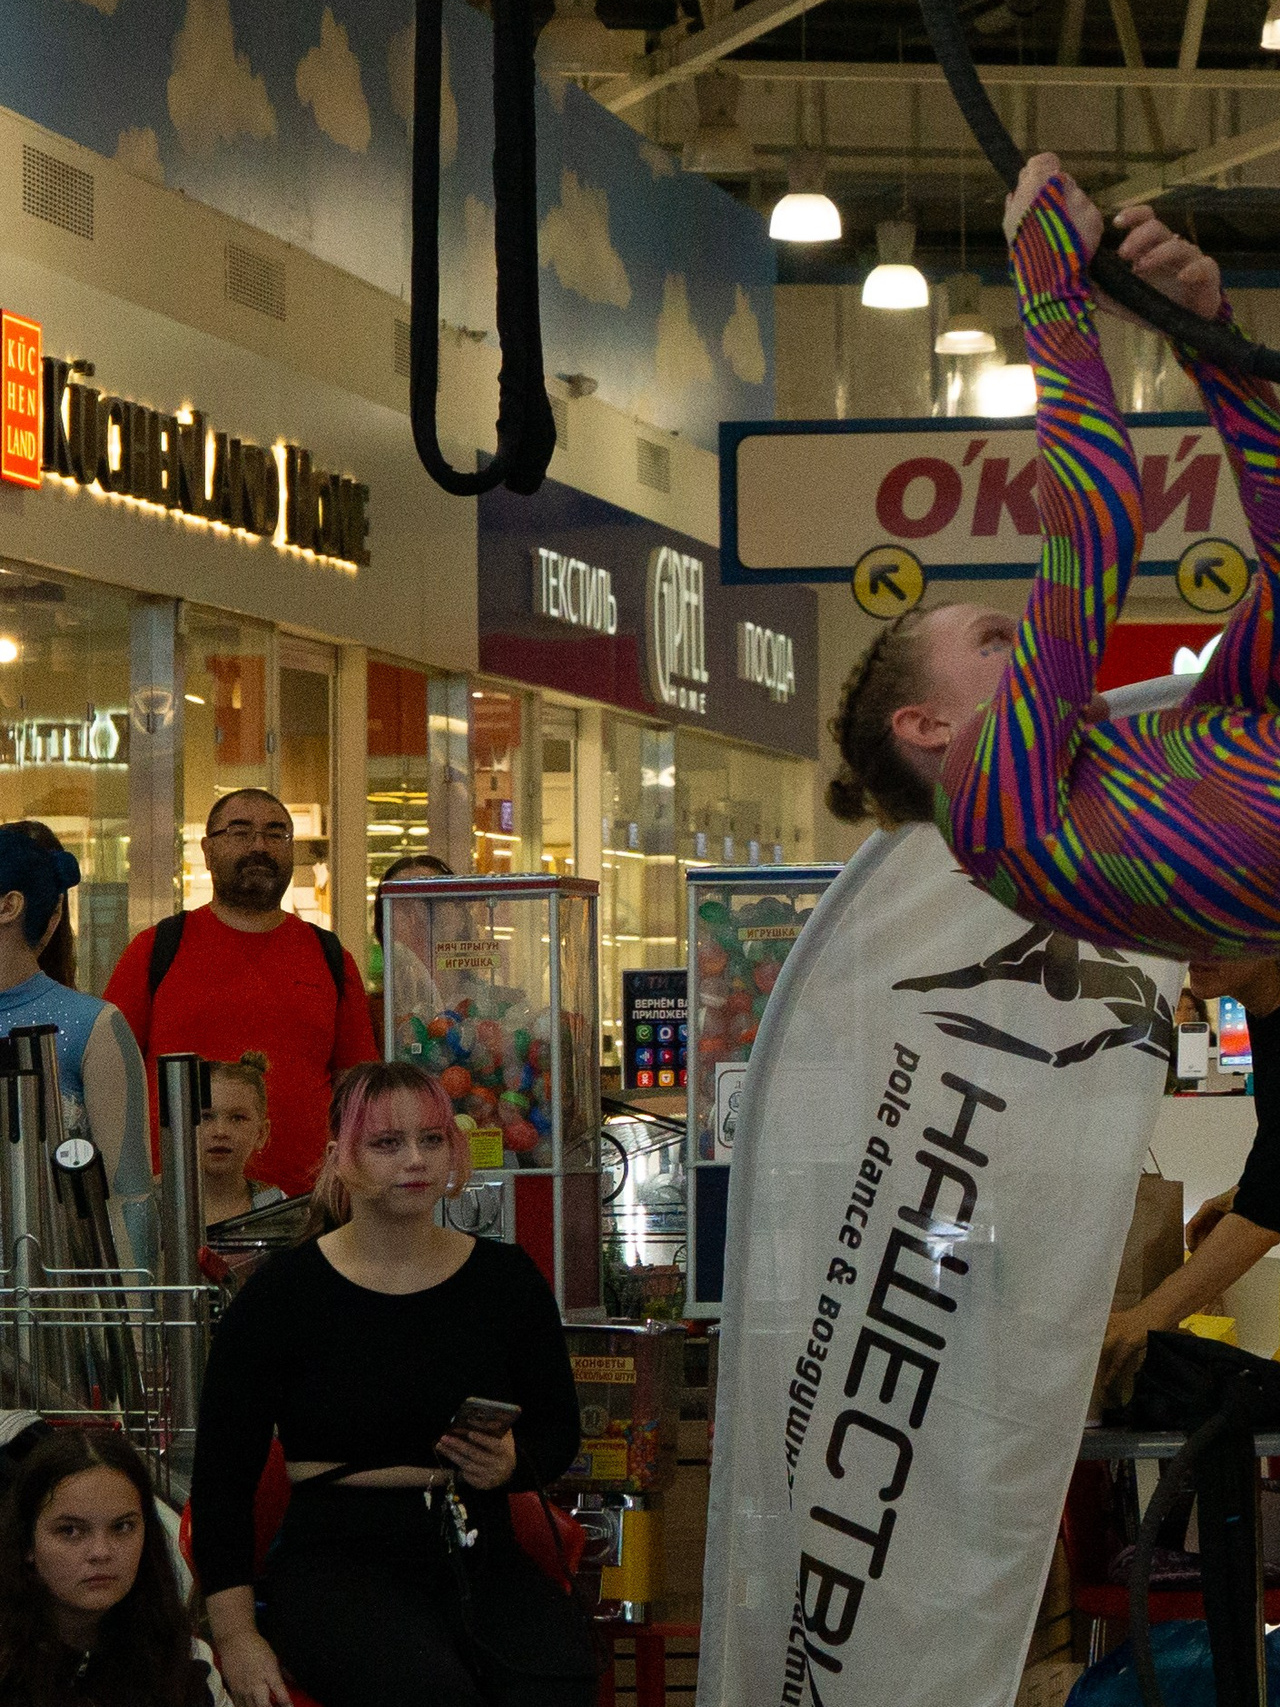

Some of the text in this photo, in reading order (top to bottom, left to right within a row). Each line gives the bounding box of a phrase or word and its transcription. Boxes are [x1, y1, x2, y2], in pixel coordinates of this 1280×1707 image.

[7, 337, 36, 377] KÜC
[7, 381, 36, 417] HEN
[7, 424, 36, 462] LAND
[875, 435, 1222, 539] О'КЙ
[538, 547, 617, 636] ТЕКСТИЛЬ
[744, 621, 796, 705] ПОСУДА
[667, 687, 707, 714] HOME
[437, 942, 499, 953] МЯЧ ПРЫГУН
[747, 927, 796, 939] ИГРУШКА
[445, 958, 495, 969] ИГРУШКА
[632, 1009, 688, 1020] ПРИЛОЖЕН
[634, 997, 675, 1009] ВЕРНЁМ
[876, 1041, 921, 1128] pole
[839, 1135, 893, 1250] dance
[826, 1256, 858, 1285] &
[574, 1358, 626, 1369] КОНФЕТЫ
[575, 1371, 613, 1382] ЕСКОЛЬКО
[785, 1293, 842, 1491] воздушн
